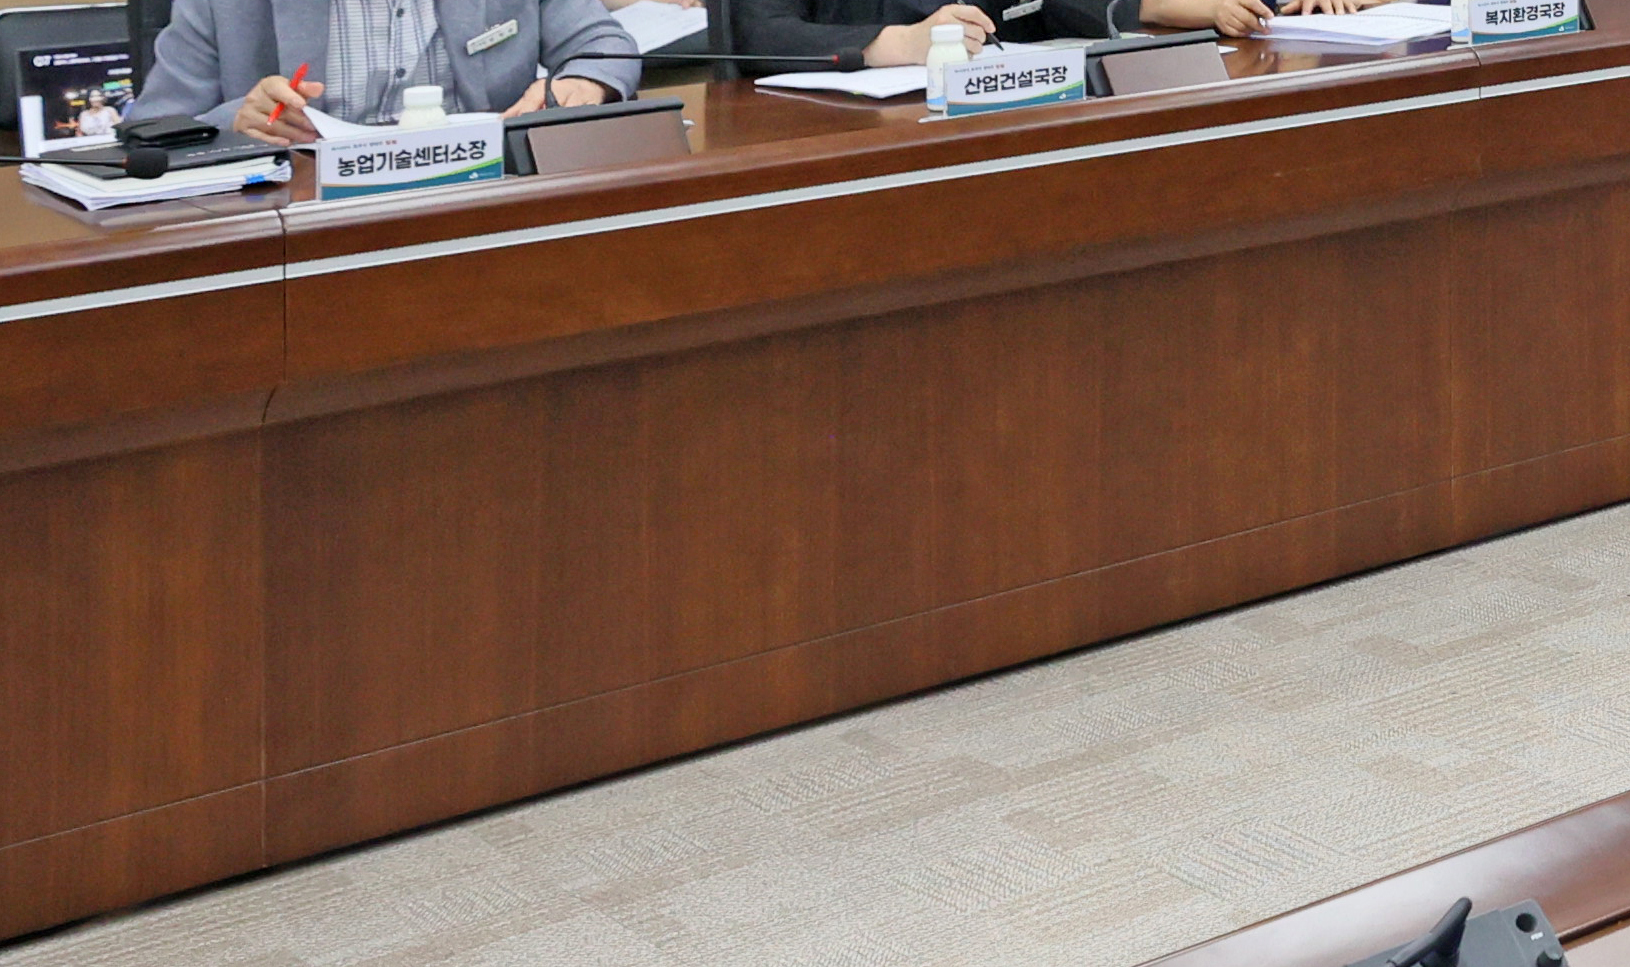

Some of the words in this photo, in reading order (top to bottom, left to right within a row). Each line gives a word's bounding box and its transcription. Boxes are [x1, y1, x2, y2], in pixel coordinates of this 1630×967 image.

[1485, 1, 1566, 26] 복지환경국장
[964, 65, 1068, 95] 산업건설국장
[337, 139, 487, 177] 농업기술센터소장
